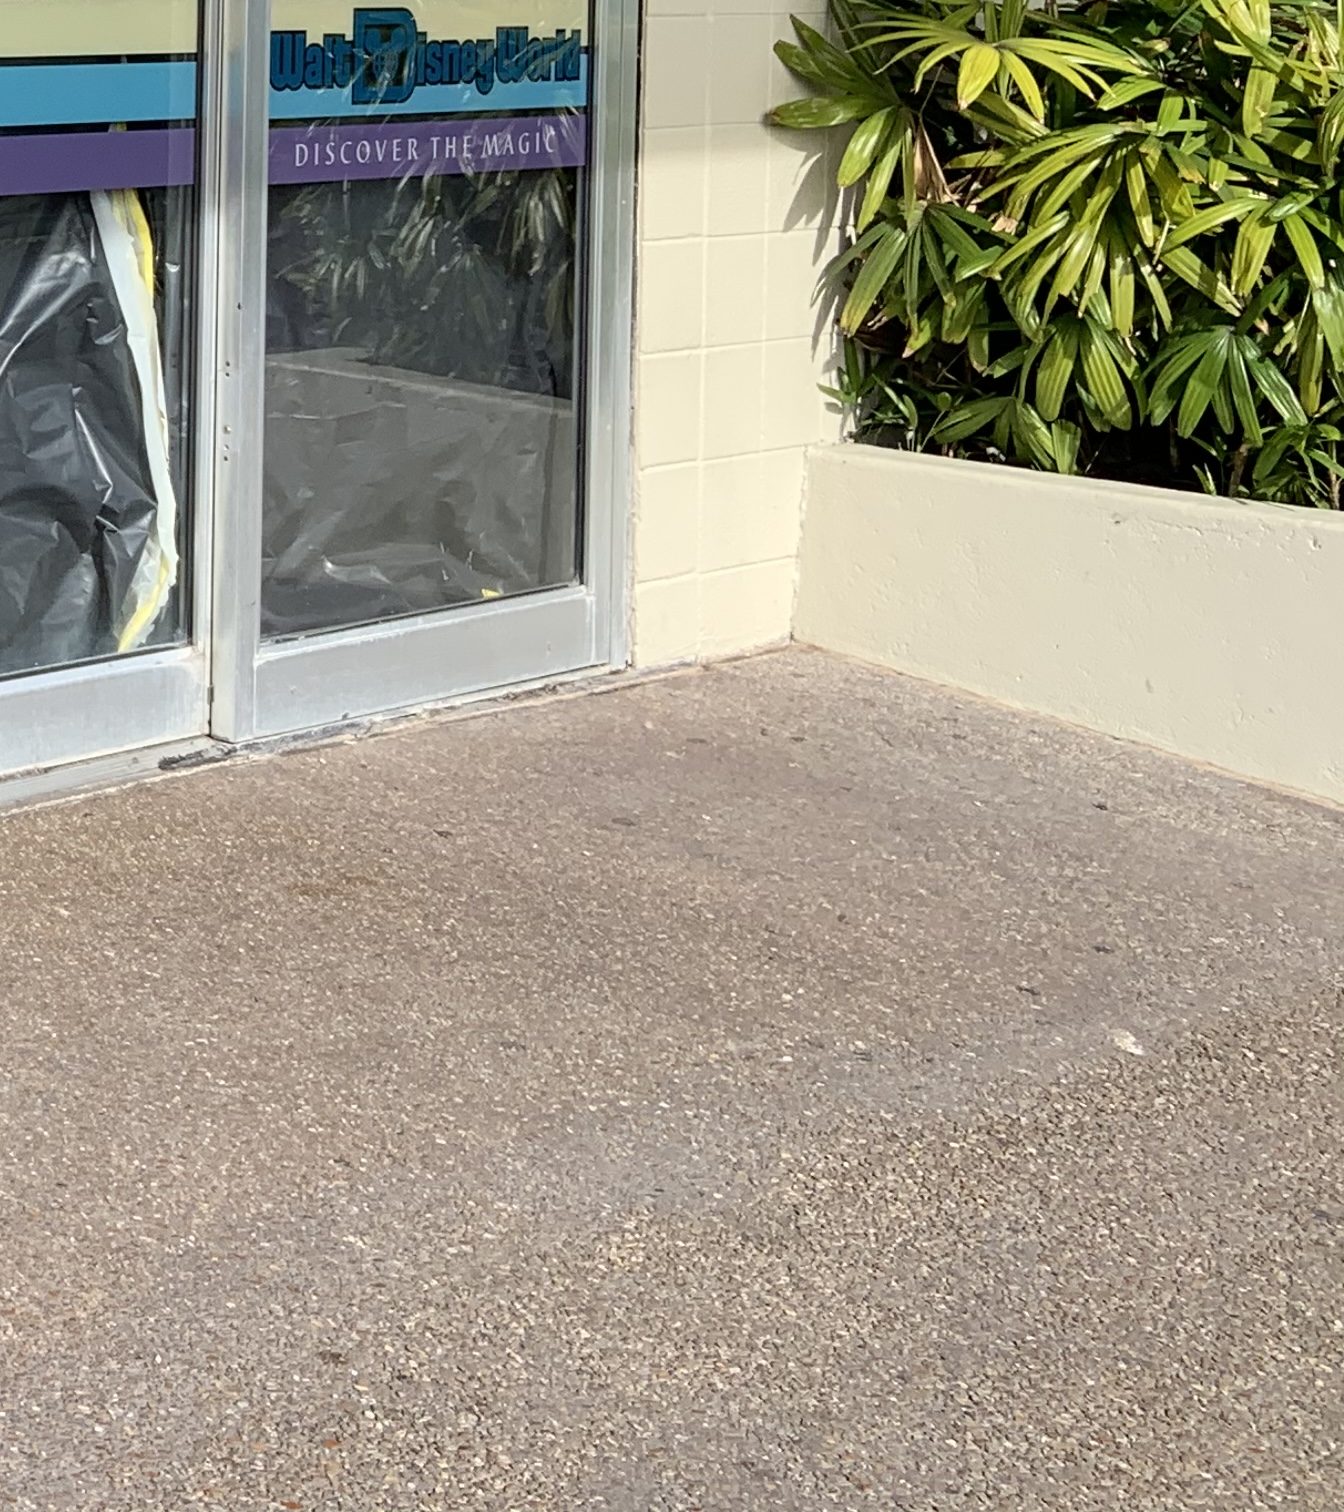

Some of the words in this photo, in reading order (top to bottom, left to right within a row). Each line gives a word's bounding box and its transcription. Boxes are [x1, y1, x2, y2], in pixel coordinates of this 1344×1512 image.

[269, 30, 356, 91] Walt
[352, 7, 495, 104] Disney
[496, 26, 582, 83] World
[294, 138, 419, 167] DISCOVER
[431, 135, 473, 160] THE
[482, 129, 557, 157] MAGIC
